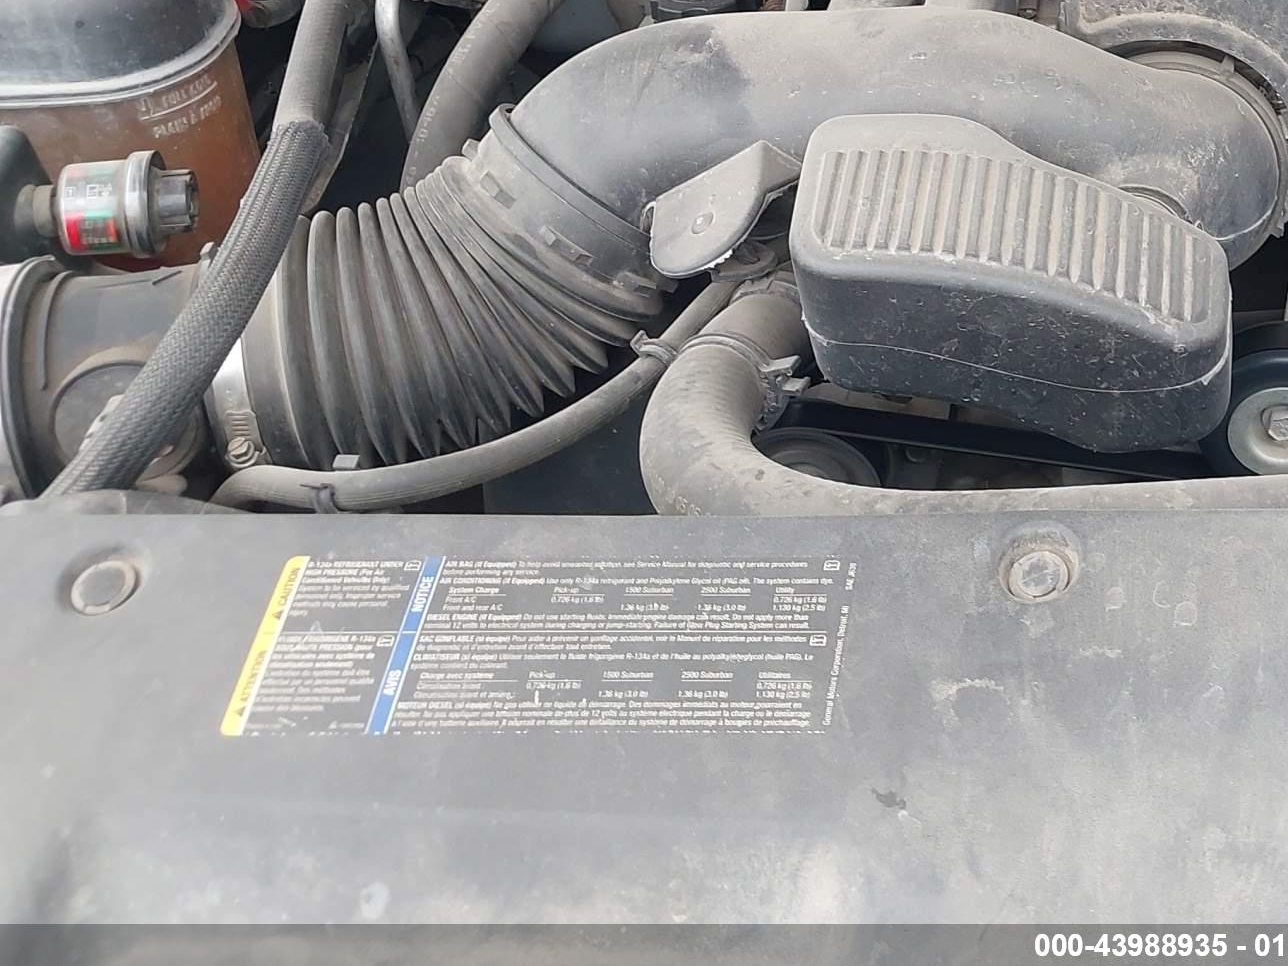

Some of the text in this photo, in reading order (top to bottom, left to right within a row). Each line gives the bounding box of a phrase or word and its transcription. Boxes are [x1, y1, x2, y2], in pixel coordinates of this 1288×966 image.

[278, 567, 302, 606] CAUTION
[411, 576, 434, 612] NOTICE
[383, 669, 402, 696] AVIS
[827, 677, 838, 699] Motors
